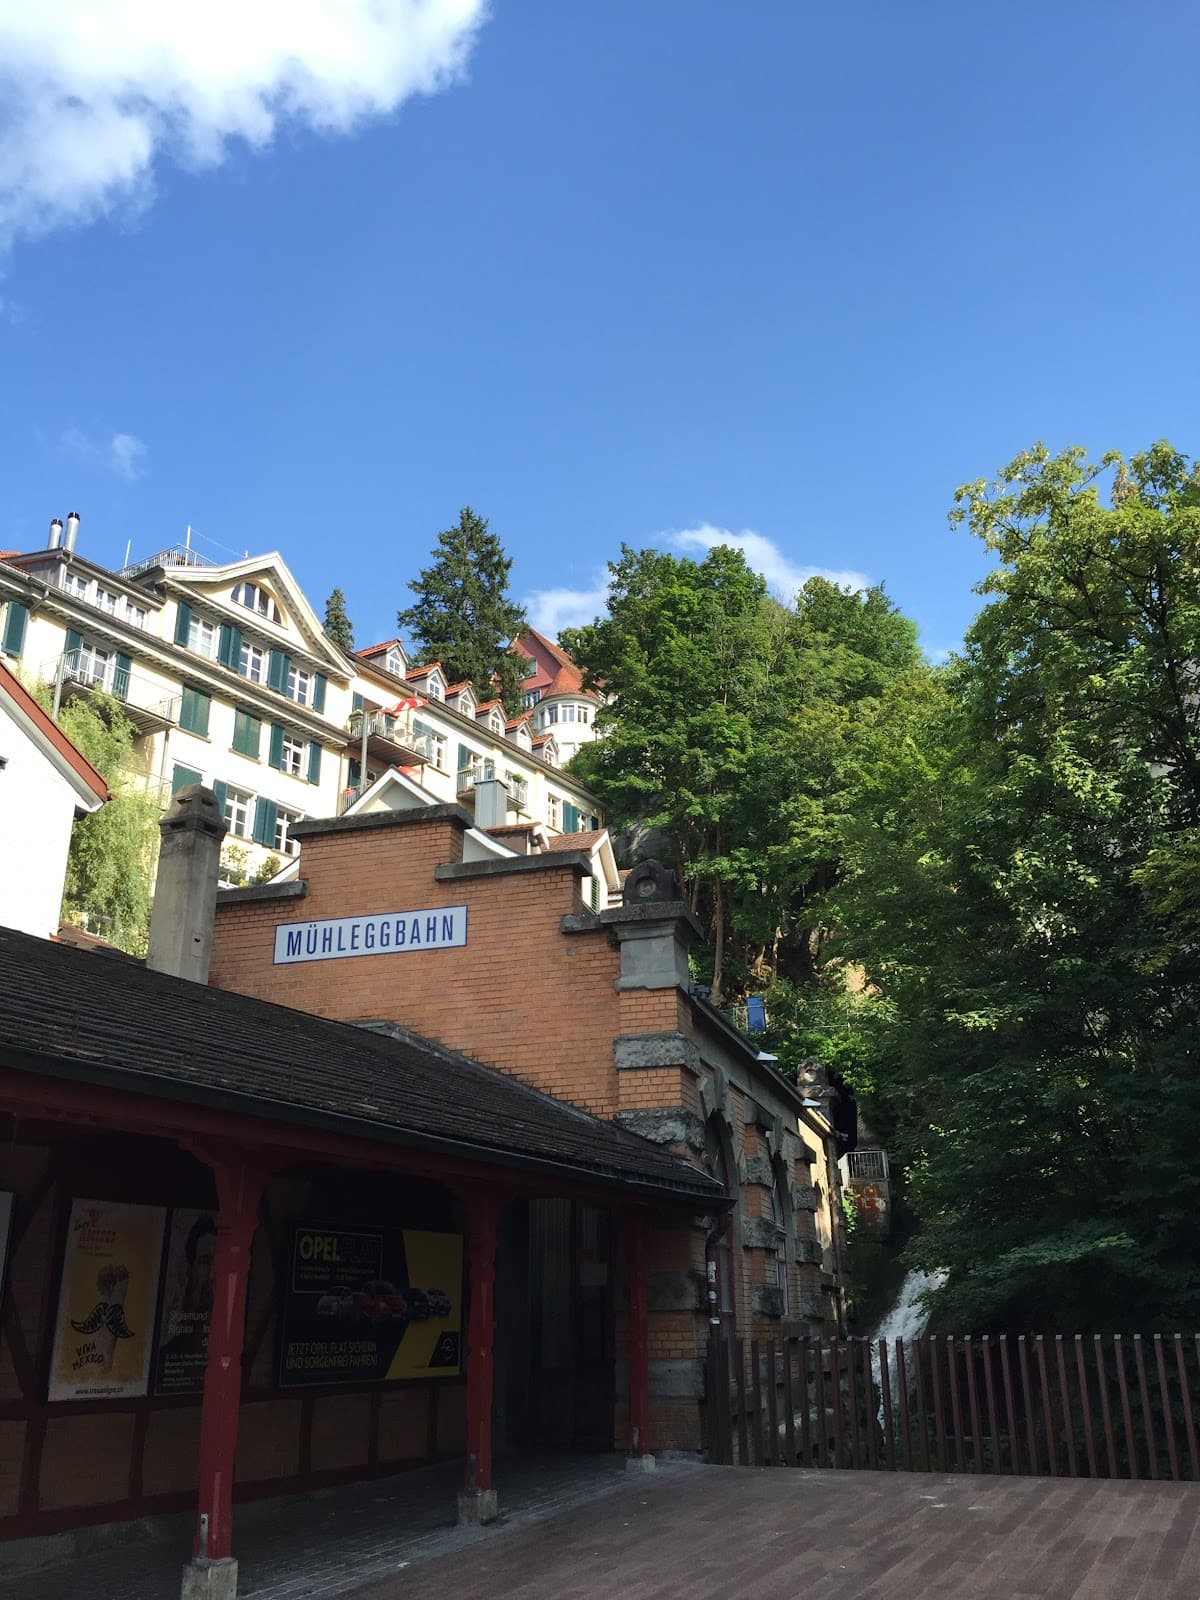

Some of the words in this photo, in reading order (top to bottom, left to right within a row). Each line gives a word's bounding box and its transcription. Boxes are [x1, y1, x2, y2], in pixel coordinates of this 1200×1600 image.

[286, 915, 454, 957] MÜHLEGGBAHN
[299, 1235, 341, 1261] OPEL
[76, 1341, 97, 1357] VIVA
[72, 1353, 104, 1371] MEXICO
